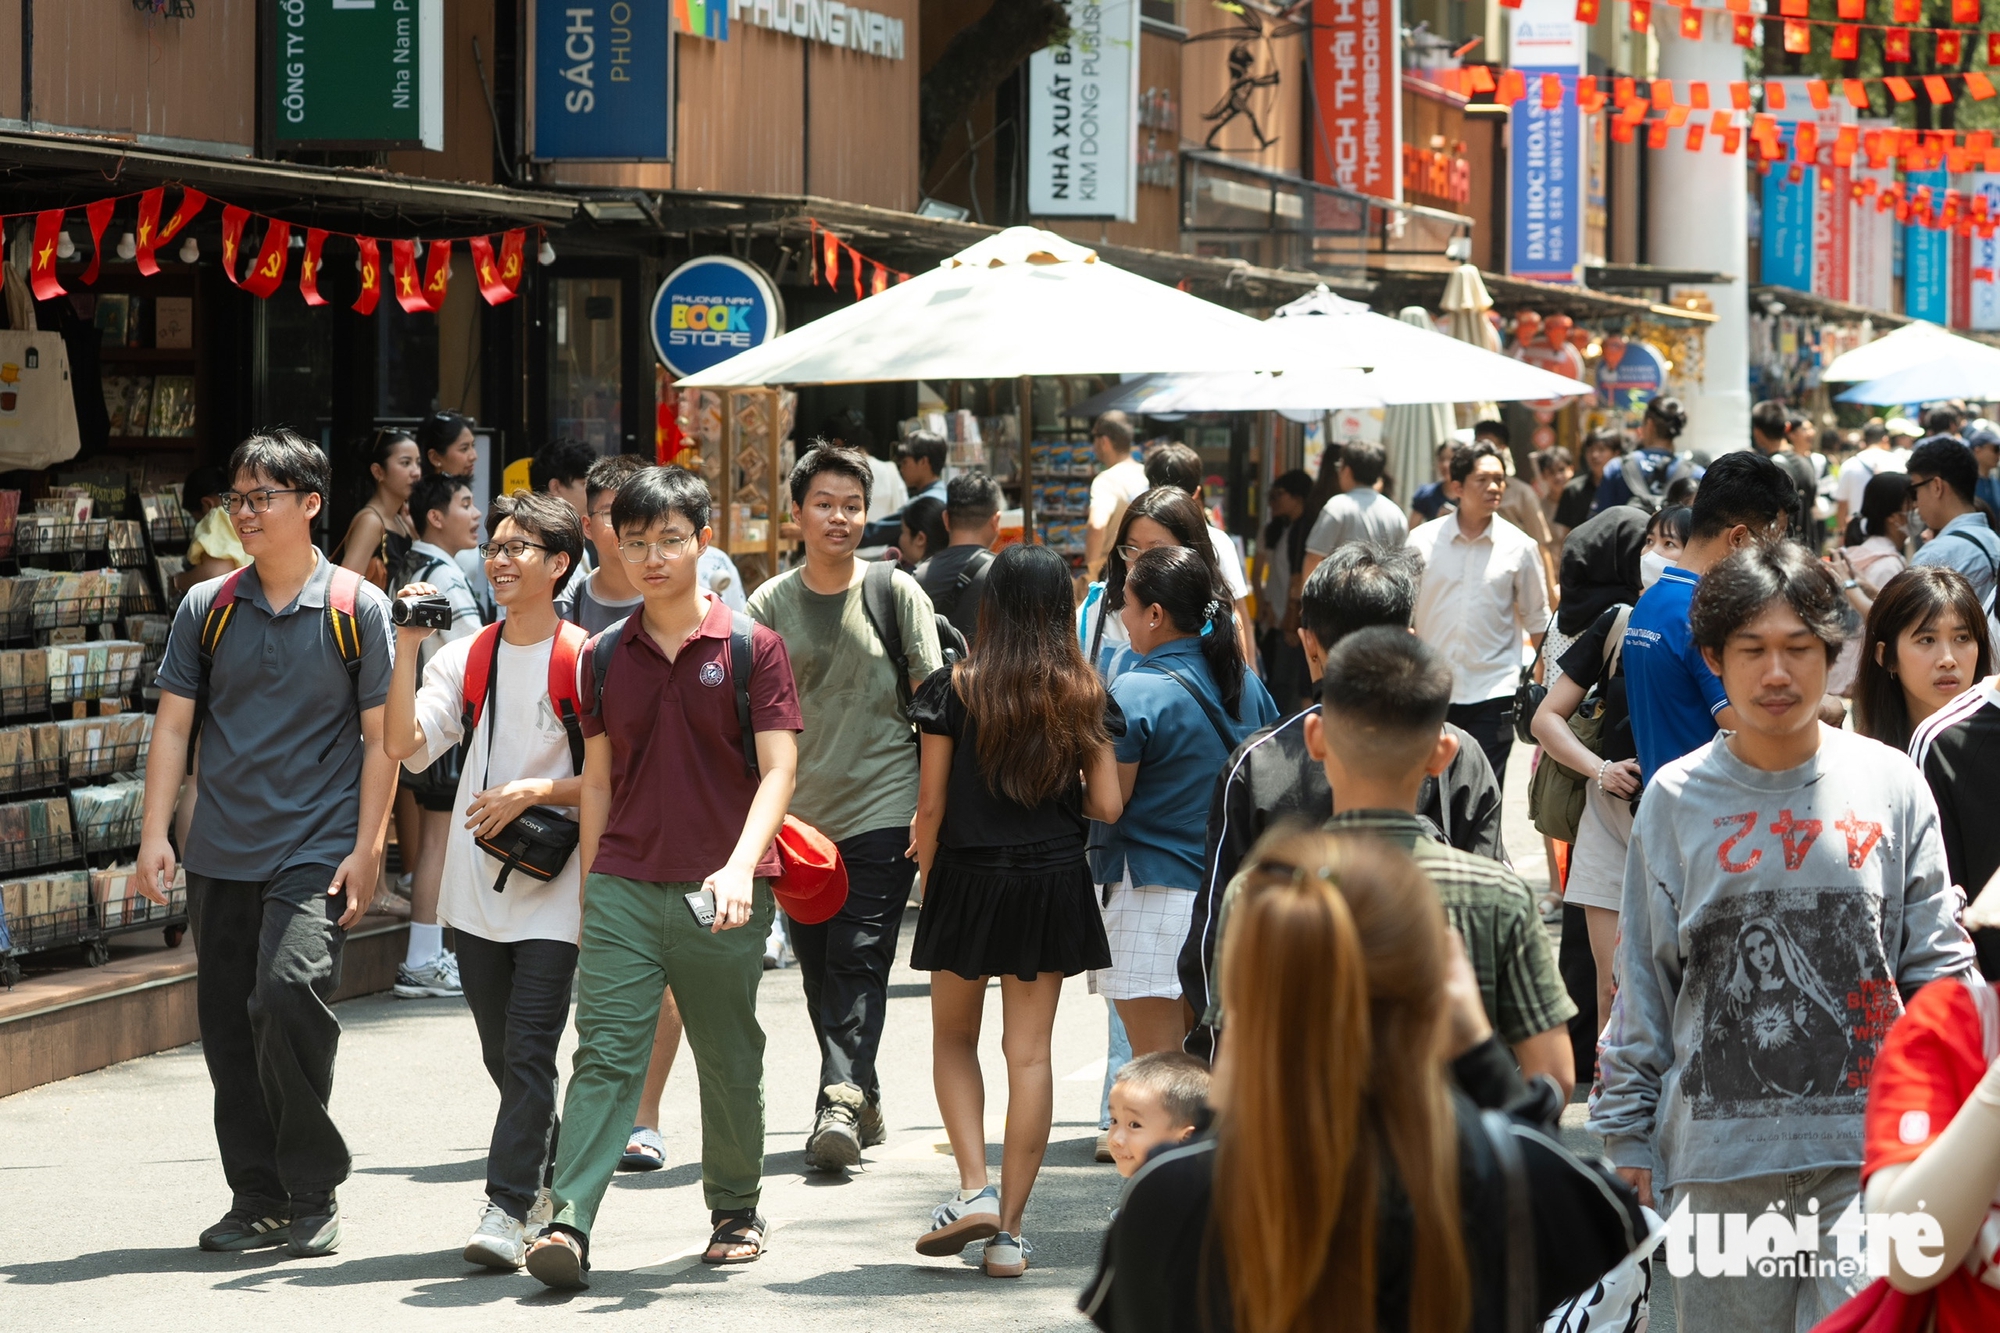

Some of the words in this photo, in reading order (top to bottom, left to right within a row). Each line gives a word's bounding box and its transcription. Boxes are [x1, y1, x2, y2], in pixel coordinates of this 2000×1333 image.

[280, 0, 305, 27] CỔ
[287, 32, 304, 58] TY
[393, 18, 410, 63] Nam
[559, 8, 595, 113] SÁCH
[282, 63, 305, 123] CÔNG
[391, 69, 410, 109] Nha
[1329, 31, 1357, 110] THÁI
[1046, 73, 1072, 138] XUẤT
[1079, 83, 1100, 156] DONG
[1330, 117, 1358, 192] ÁCH
[1548, 106, 1564, 182] UNIVERS
[1047, 143, 1070, 200] NHÀ
[1078, 161, 1099, 201] KIM
[670, 303, 752, 331] BOOK
[725, 296, 754, 305] NAM
[668, 330, 752, 347] STORE
[519, 816, 544, 833] SONY
